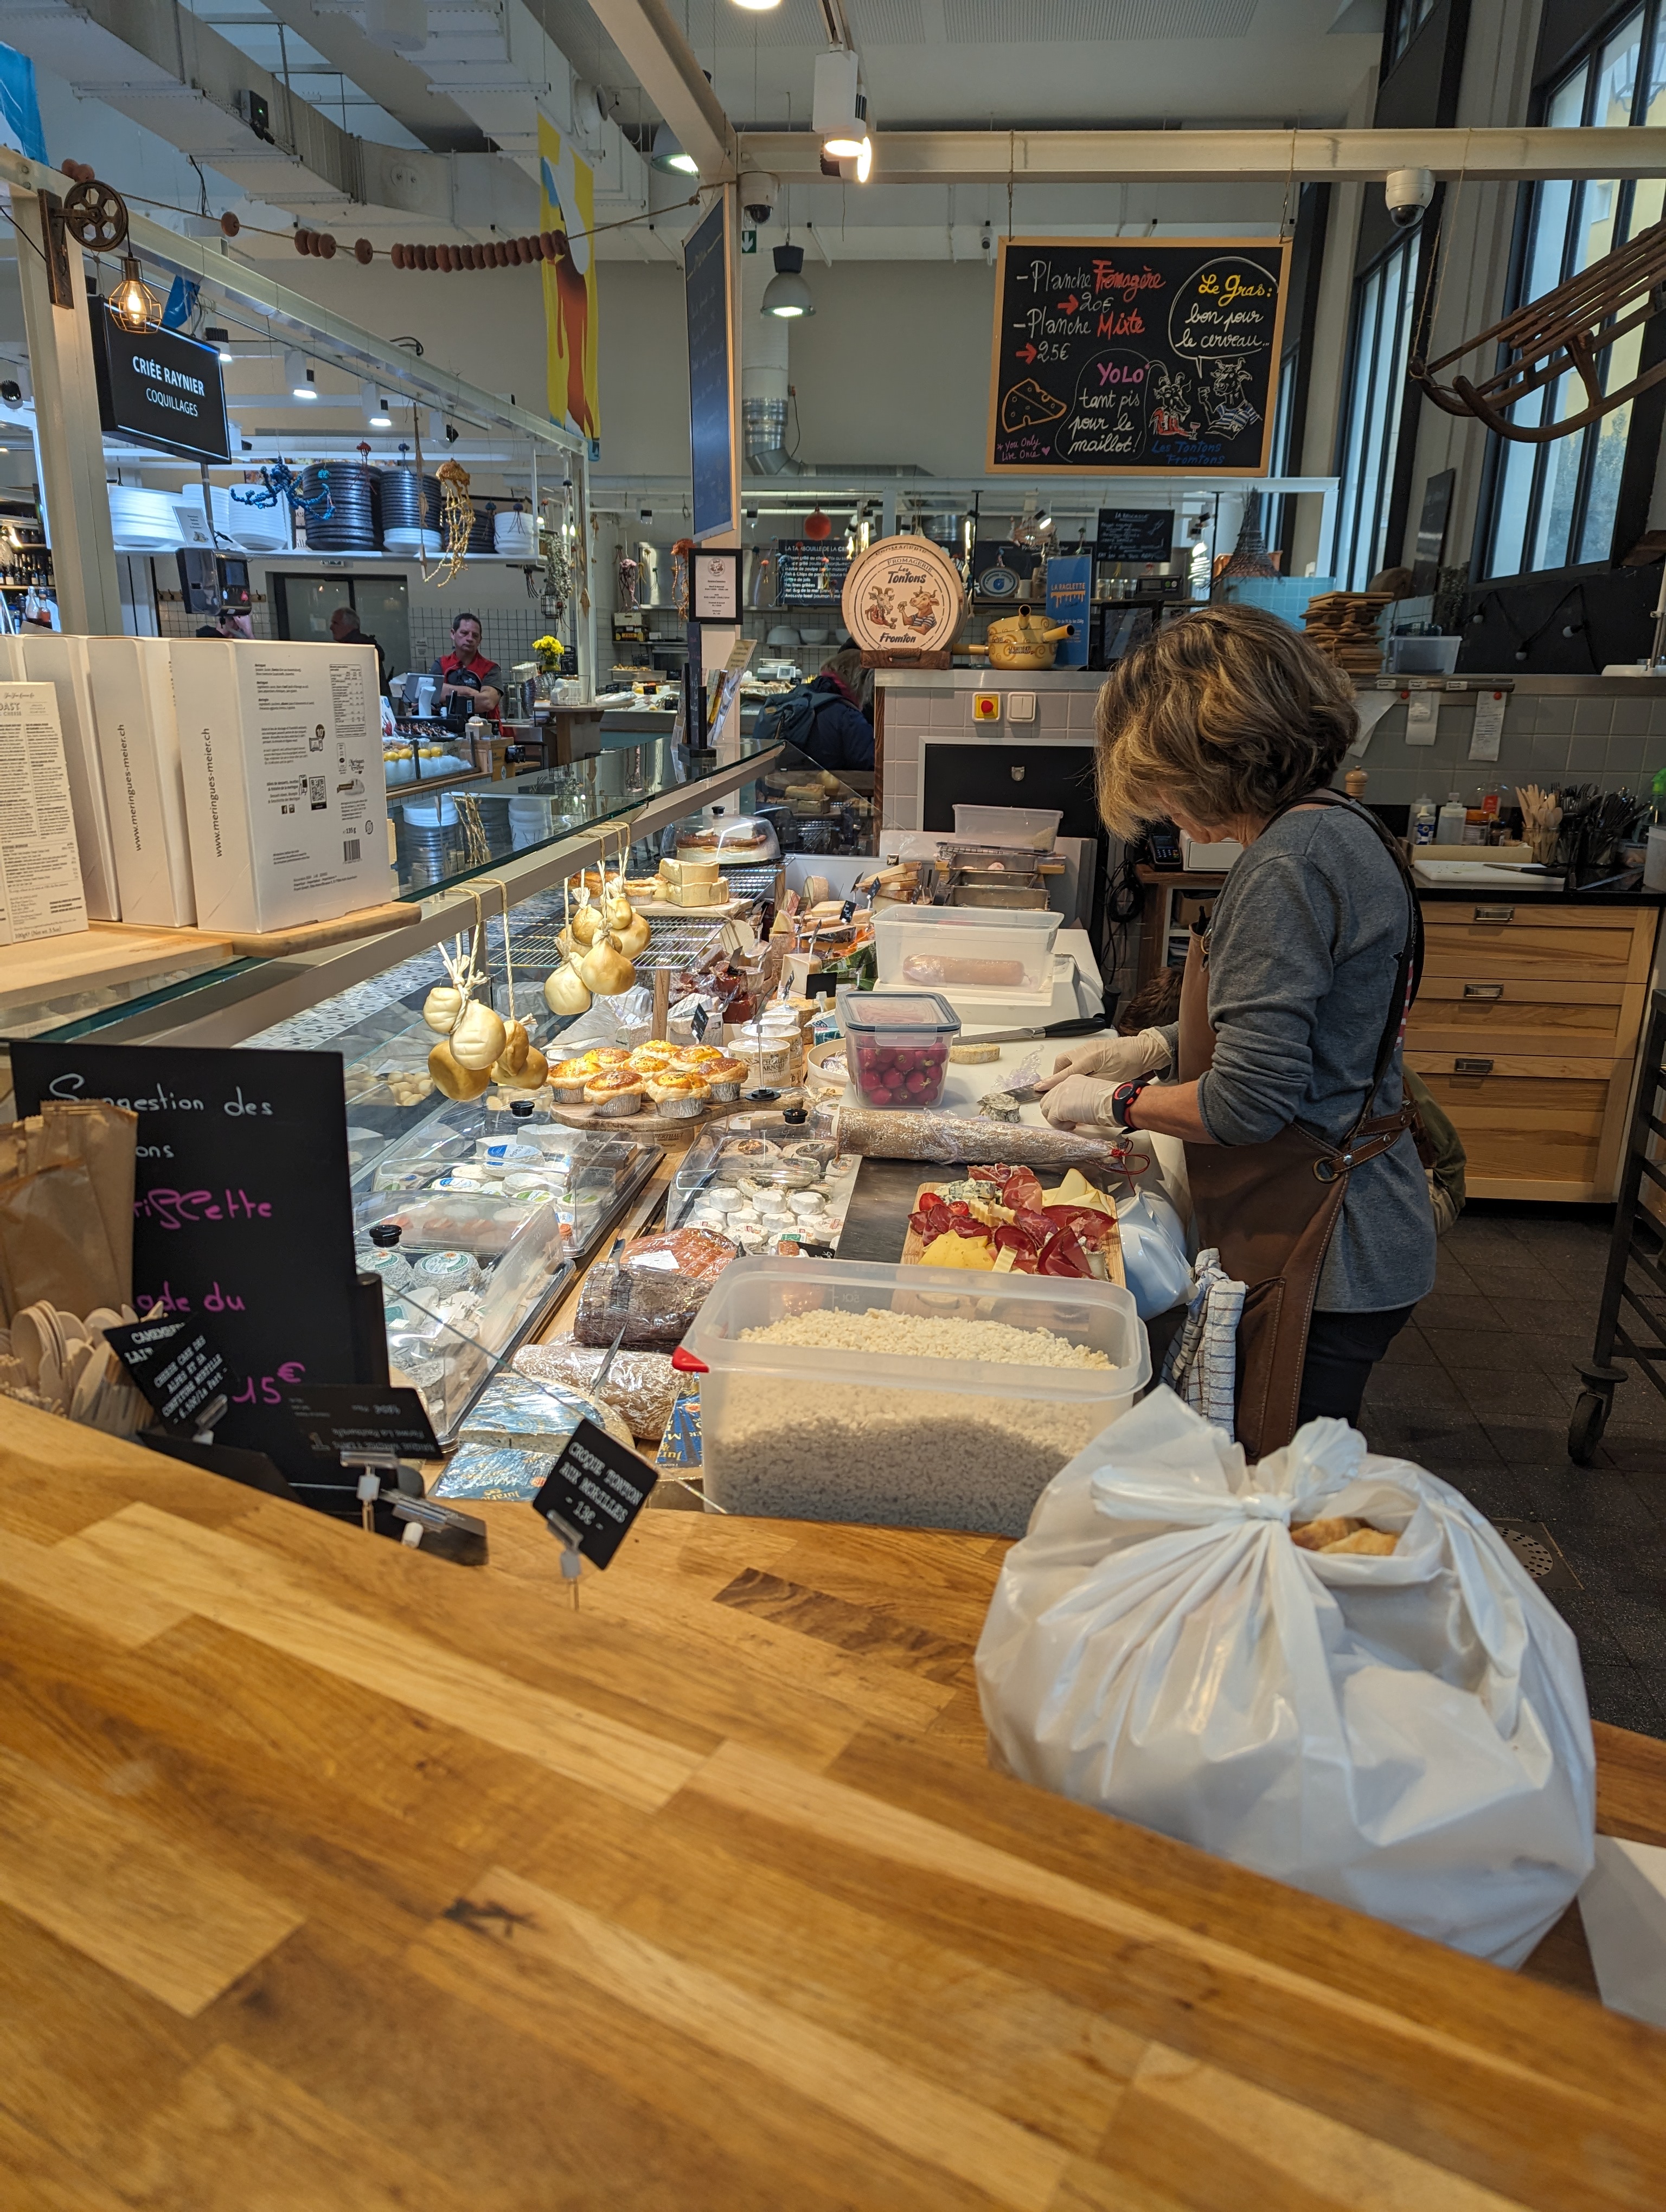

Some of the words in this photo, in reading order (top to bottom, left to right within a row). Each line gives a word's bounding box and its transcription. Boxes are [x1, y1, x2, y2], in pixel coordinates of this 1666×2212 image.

[1199, 274, 1220, 294] Le
[1080, 291, 1114, 313] 20€
[1097, 307, 1145, 340] Mixte
[1185, 303, 1224, 324] bon
[1223, 310, 1264, 332] pour
[1037, 340, 1071, 363] 25€
[1175, 327, 1197, 348] le
[132, 356, 163, 381] CRIÉE
[163, 366, 206, 397] RAYNIER
[146, 388, 198, 417] COQUILLAGES
[1078, 388, 1116, 409] tant
[1117, 391, 1139, 418] pis
[1068, 415, 1109, 440] pour
[1113, 412, 1135, 432] le
[1020, 449, 1041, 459] Once
[1021, 435, 1041, 449] Only
[1151, 440, 1172, 454] Les
[1175, 440, 1222, 453] Tontons
[1167, 453, 1225, 465] Fromtons
[887, 558, 933, 573] FROMAGERIE
[887, 571, 927, 584] Tontons
[879, 632, 917, 644] Fromton
[117, 724, 142, 851] www.meringues-meier.ch
[201, 728, 223, 858] www.meringues-meier.ch
[223, 1085, 273, 1116] des
[203, 1281, 246, 1312] du
[232, 1361, 306, 1405] 15€
[568, 1441, 606, 1476] CROQUE
[603, 1468, 644, 1507] TONTON
[559, 1461, 582, 1485] AUX
[578, 1477, 629, 1523] MORILLES
